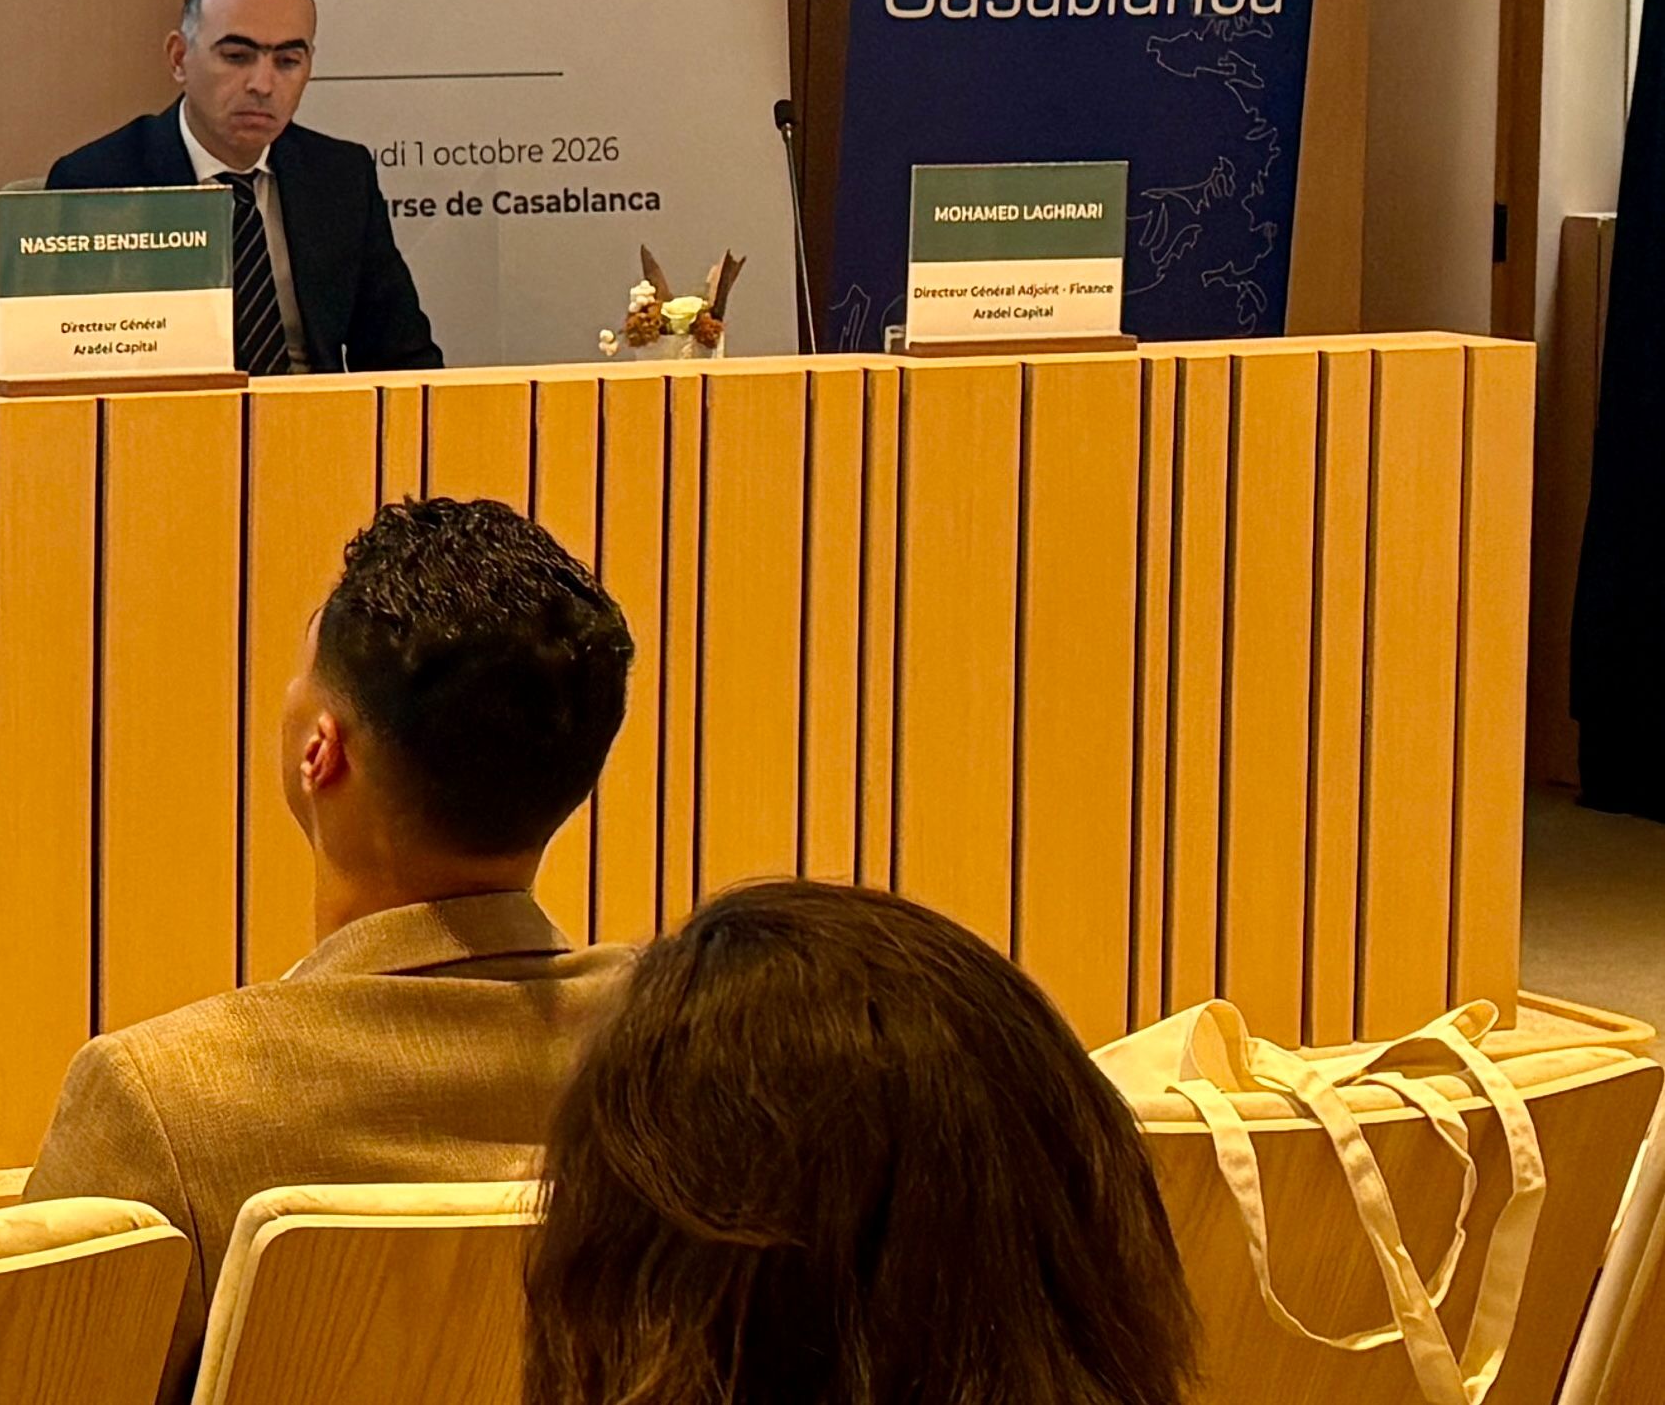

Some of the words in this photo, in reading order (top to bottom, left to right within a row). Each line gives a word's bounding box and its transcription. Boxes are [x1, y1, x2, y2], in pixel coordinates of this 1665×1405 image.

[415, 141, 423, 166] 1
[434, 138, 543, 166] octobre
[552, 136, 619, 162] 2026
[386, 197, 438, 218] rse
[446, 191, 483, 216] de
[492, 187, 660, 215] Casablanca
[935, 205, 1019, 221] MOHAMED
[1024, 203, 1102, 220] LAGHRARI
[21, 235, 89, 253] NASSER
[94, 231, 206, 250] BENJELLOUN
[61, 322, 116, 334] Directeur
[120, 318, 166, 331] Général
